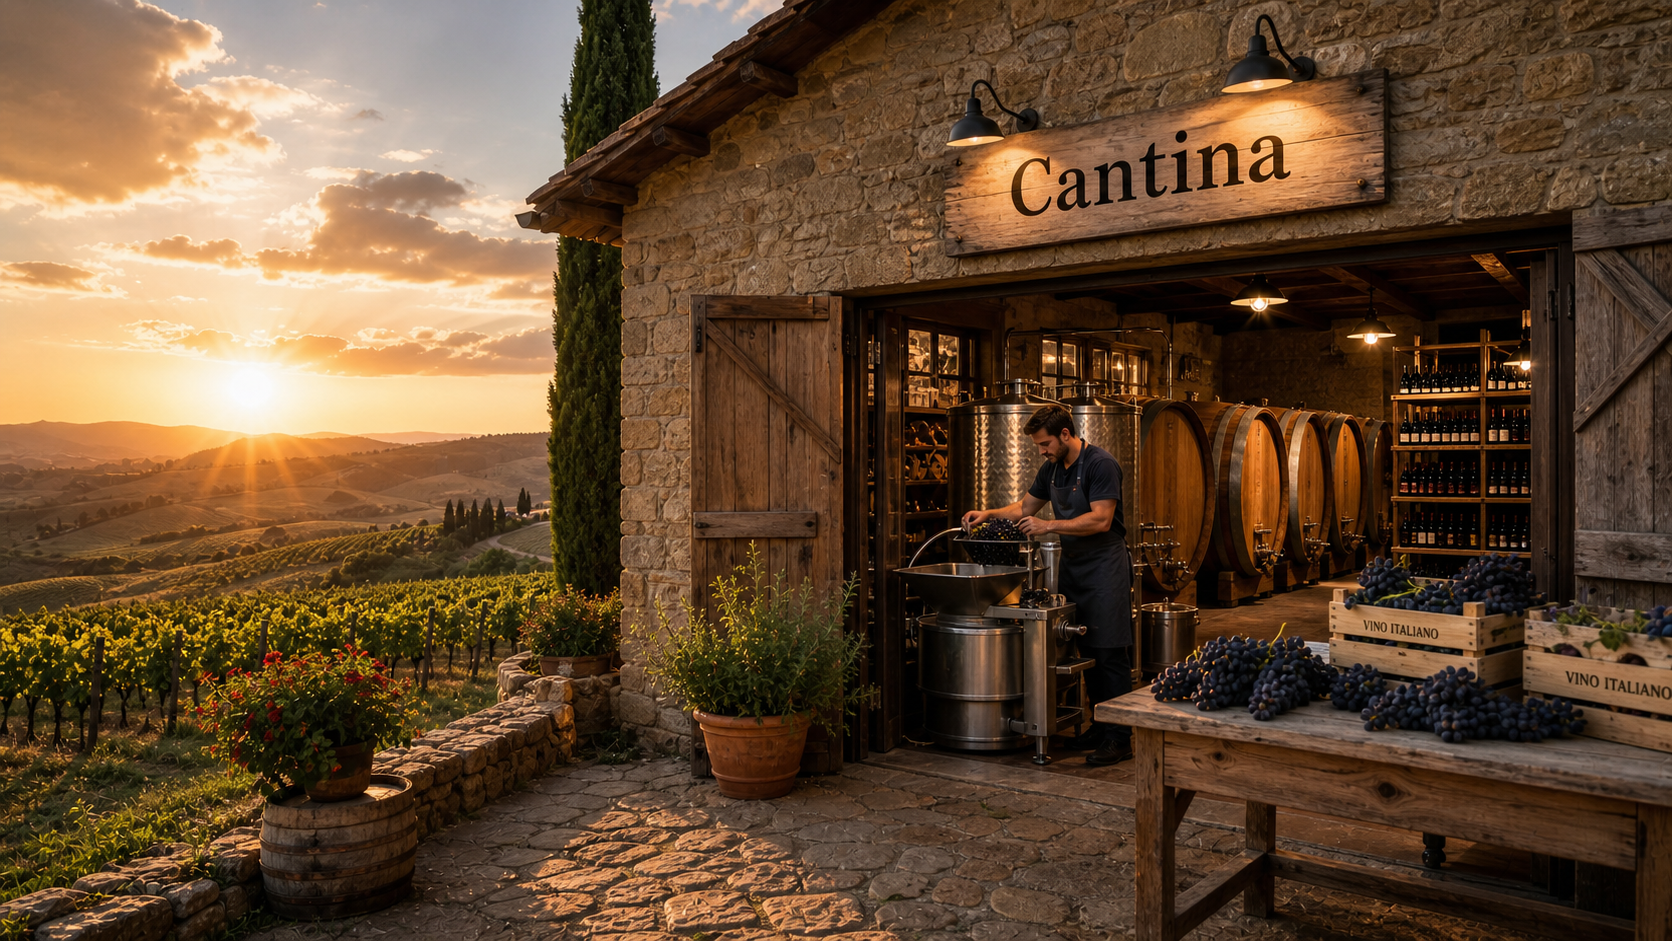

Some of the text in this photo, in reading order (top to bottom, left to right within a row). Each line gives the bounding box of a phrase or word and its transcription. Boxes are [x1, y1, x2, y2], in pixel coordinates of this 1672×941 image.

[1010, 130, 1291, 217] Cantina
[1363, 619, 1439, 640] VINO ITALIANO
[1565, 670, 1672, 701] VINO ITALIANO
